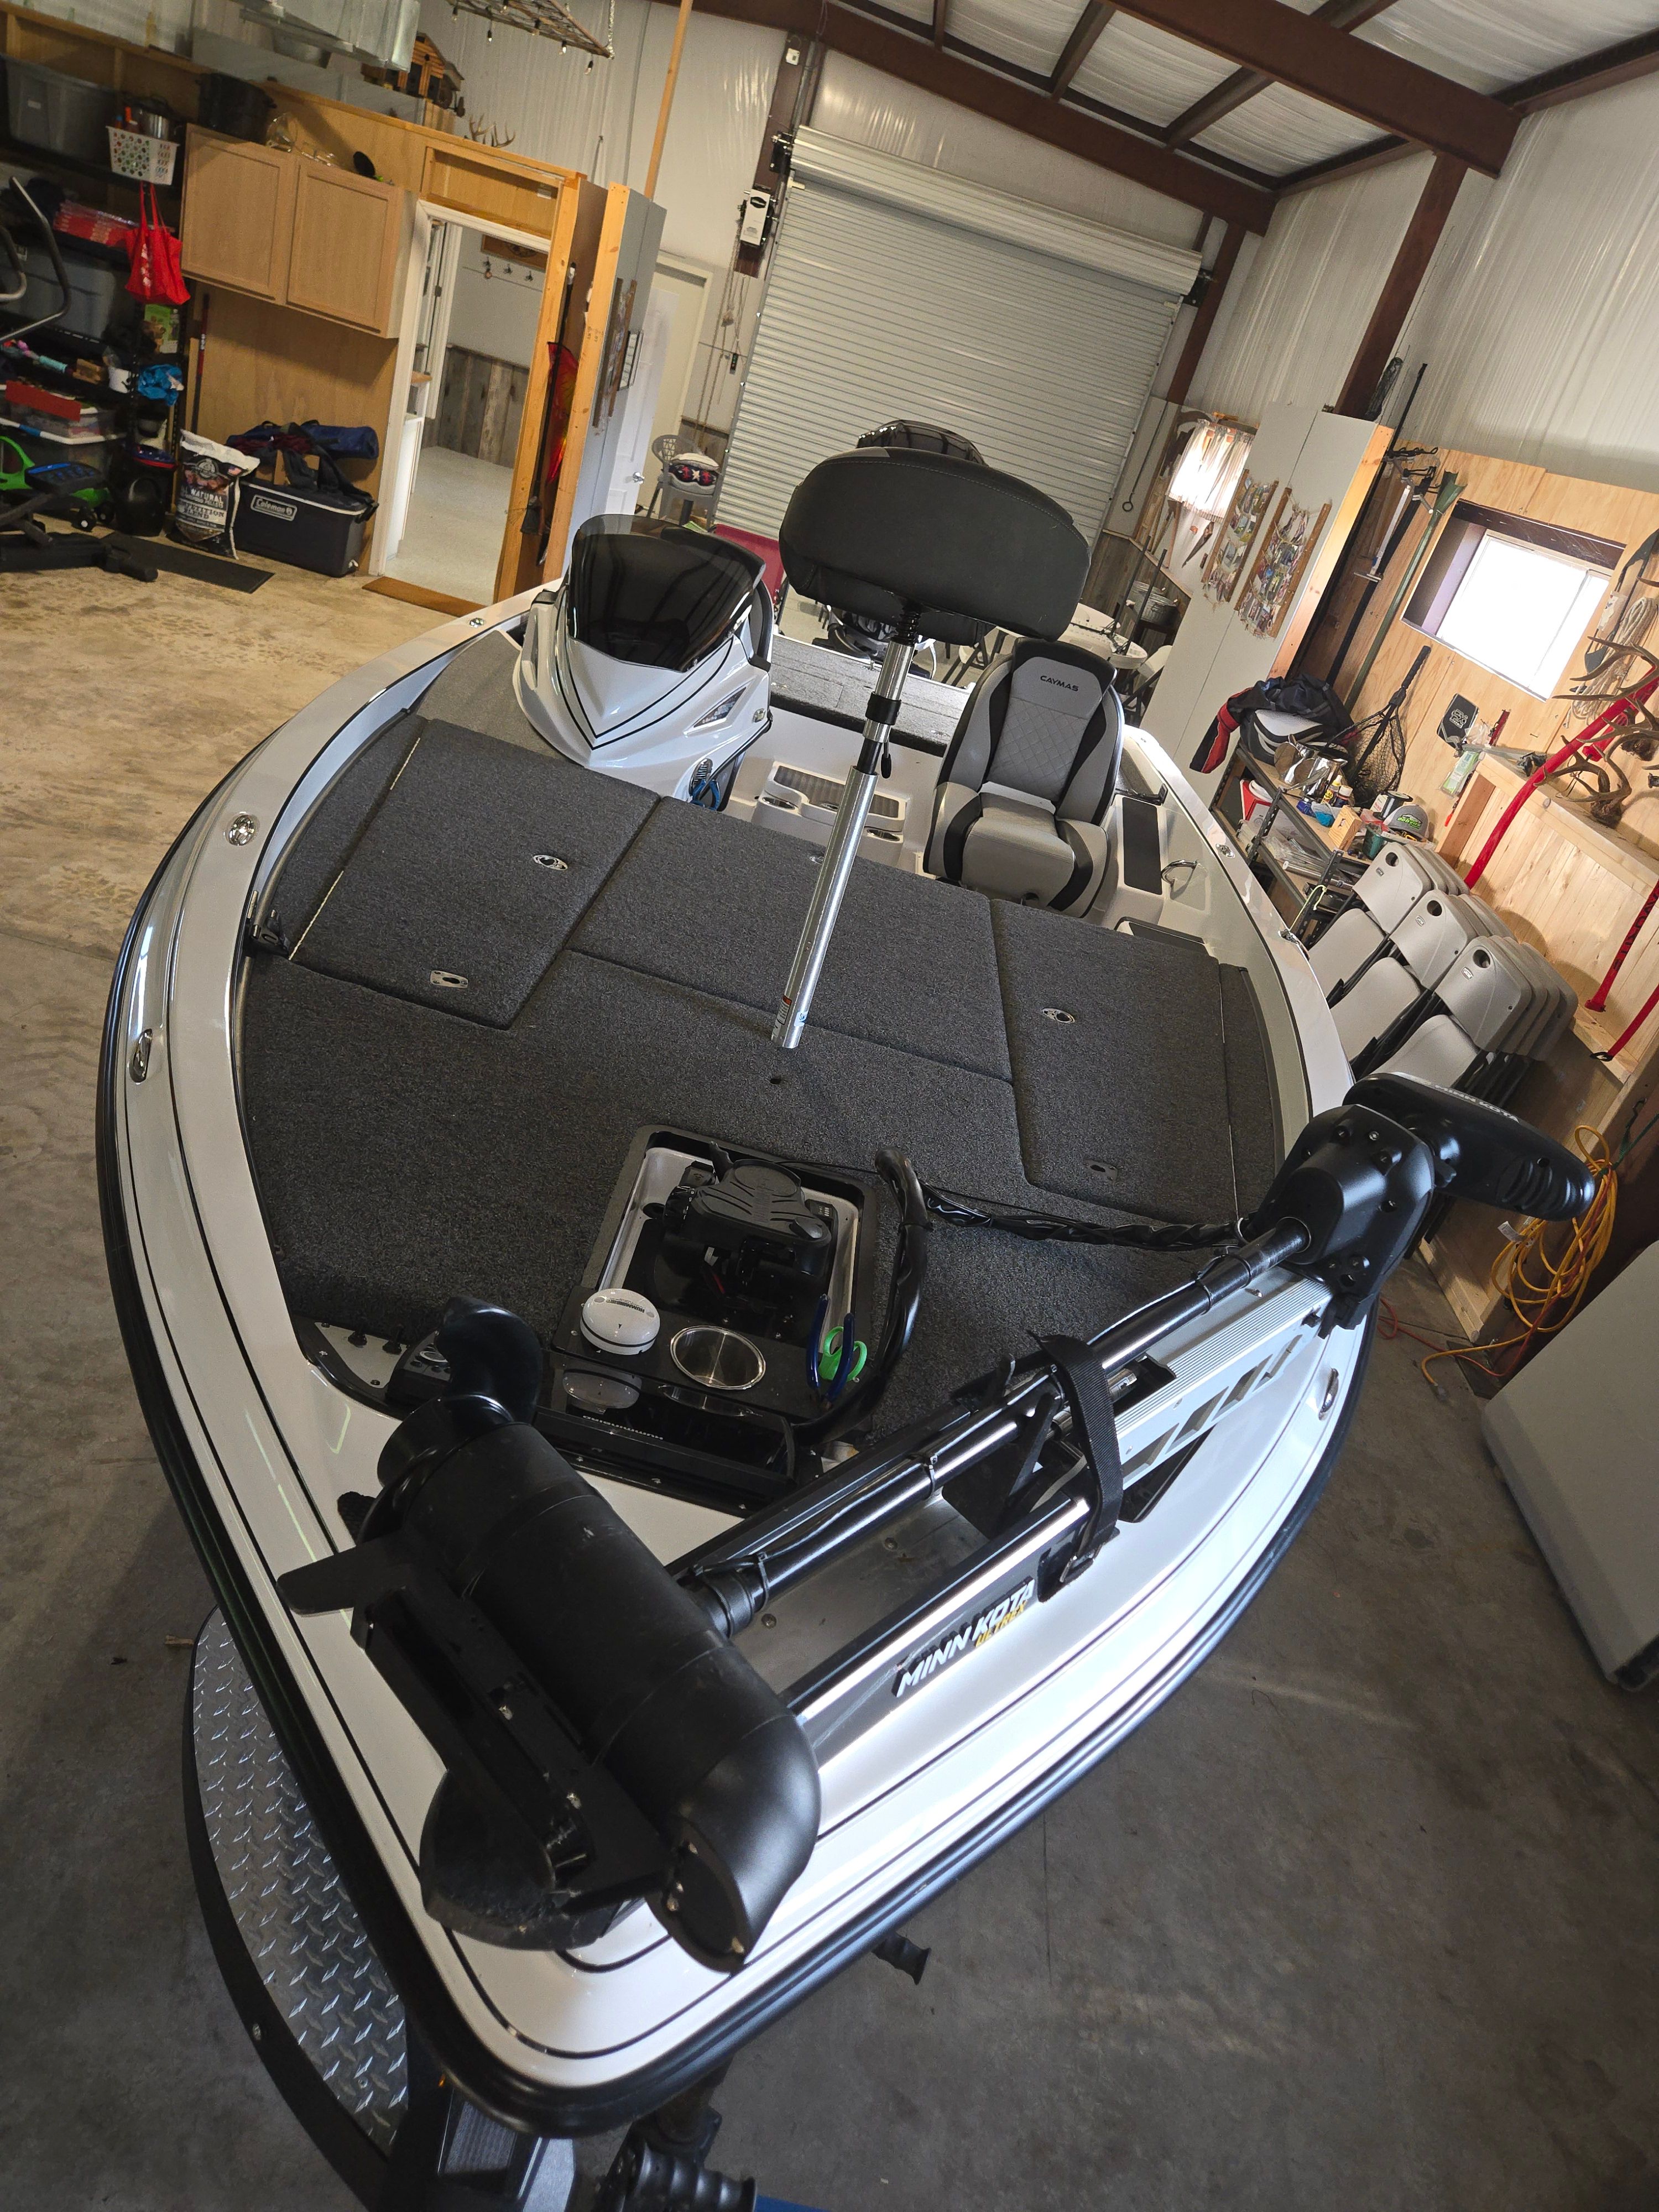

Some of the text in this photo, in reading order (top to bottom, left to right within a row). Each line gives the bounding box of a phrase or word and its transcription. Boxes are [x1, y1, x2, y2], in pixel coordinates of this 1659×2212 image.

[256, 498, 286, 513] Coleman
[1040, 675, 1079, 692] CAYMAS
[1435, 1084, 1520, 1123] MINN KOTA
[896, 1579, 1035, 1698] MINN KOTA
